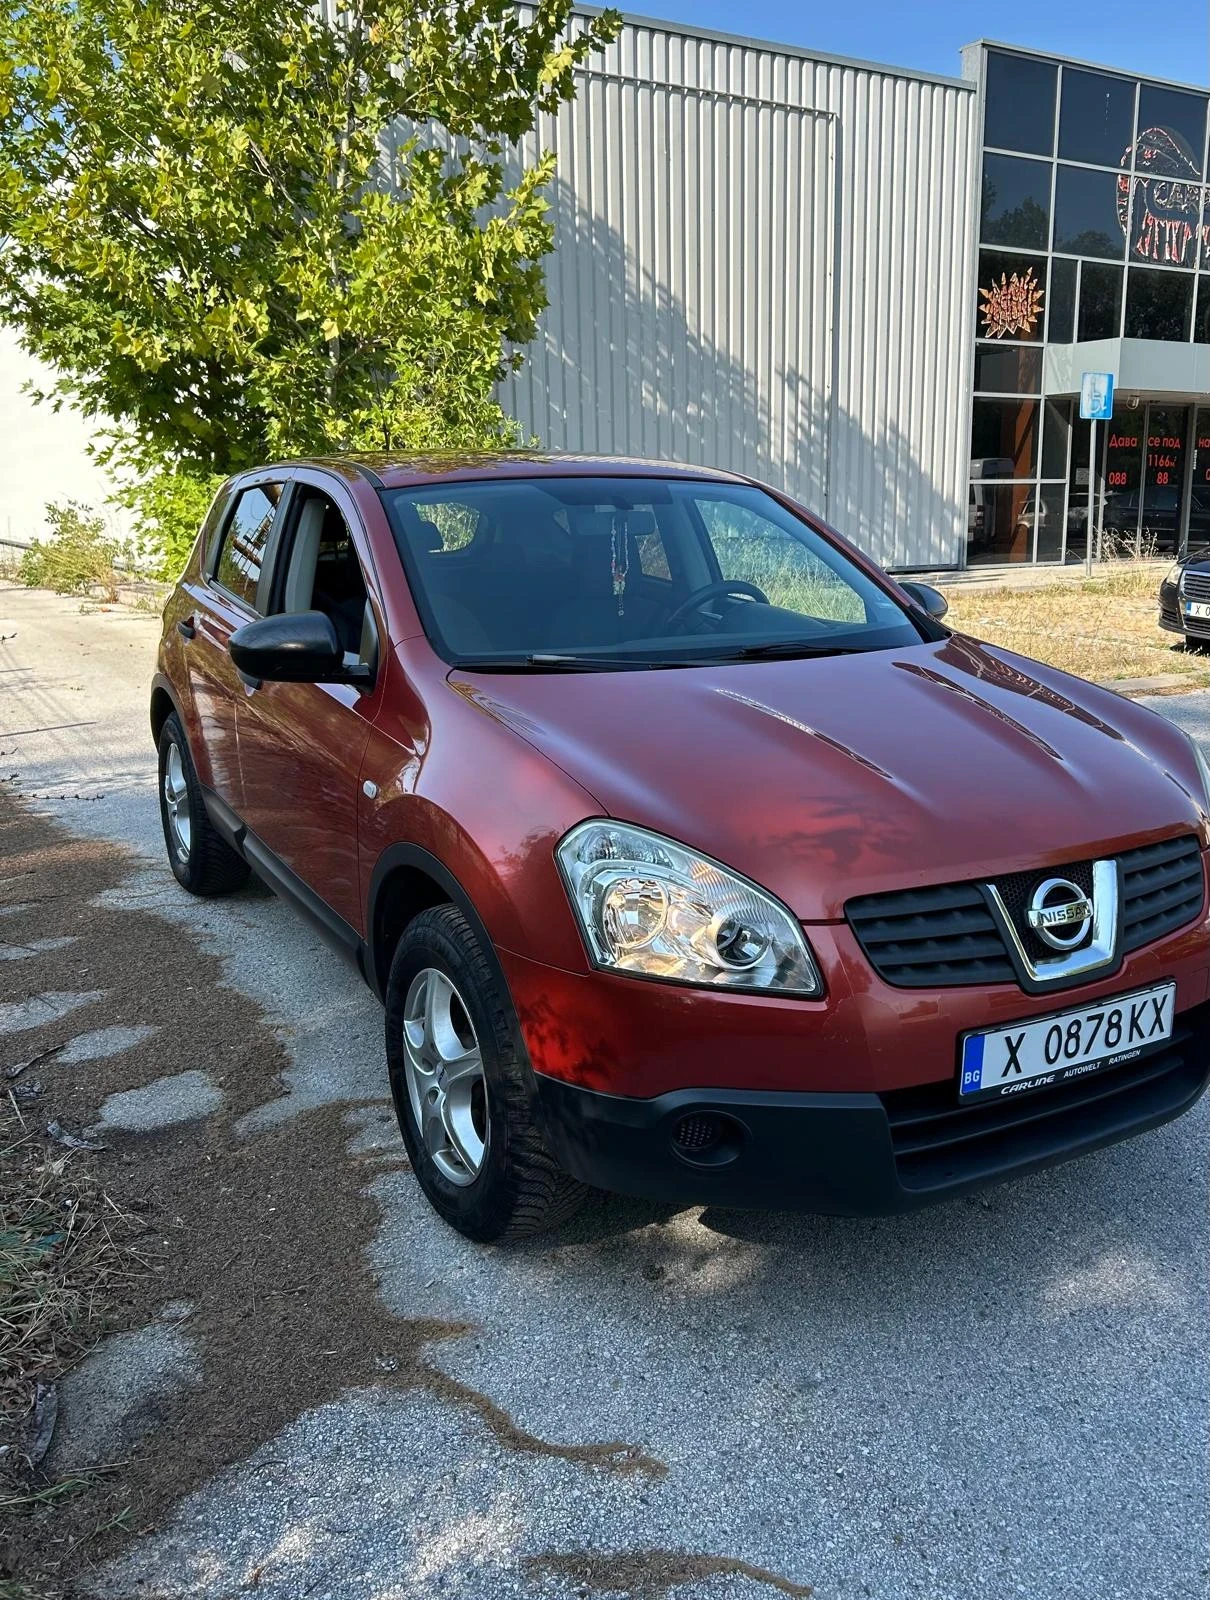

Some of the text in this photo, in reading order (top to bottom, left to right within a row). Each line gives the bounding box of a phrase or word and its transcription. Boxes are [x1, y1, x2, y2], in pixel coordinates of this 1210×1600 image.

[1109, 434, 1138, 448] Дава
[1148, 436, 1160, 447] се
[1162, 436, 1181, 449] под
[1108, 472, 1127, 485] 088
[1156, 472, 1169, 485] 88
[1001, 1032, 1026, 1078] X
[964, 1069, 980, 1085] BG
[1000, 1049, 1141, 1095] CARLINE AUTOWELT RATINGEN
